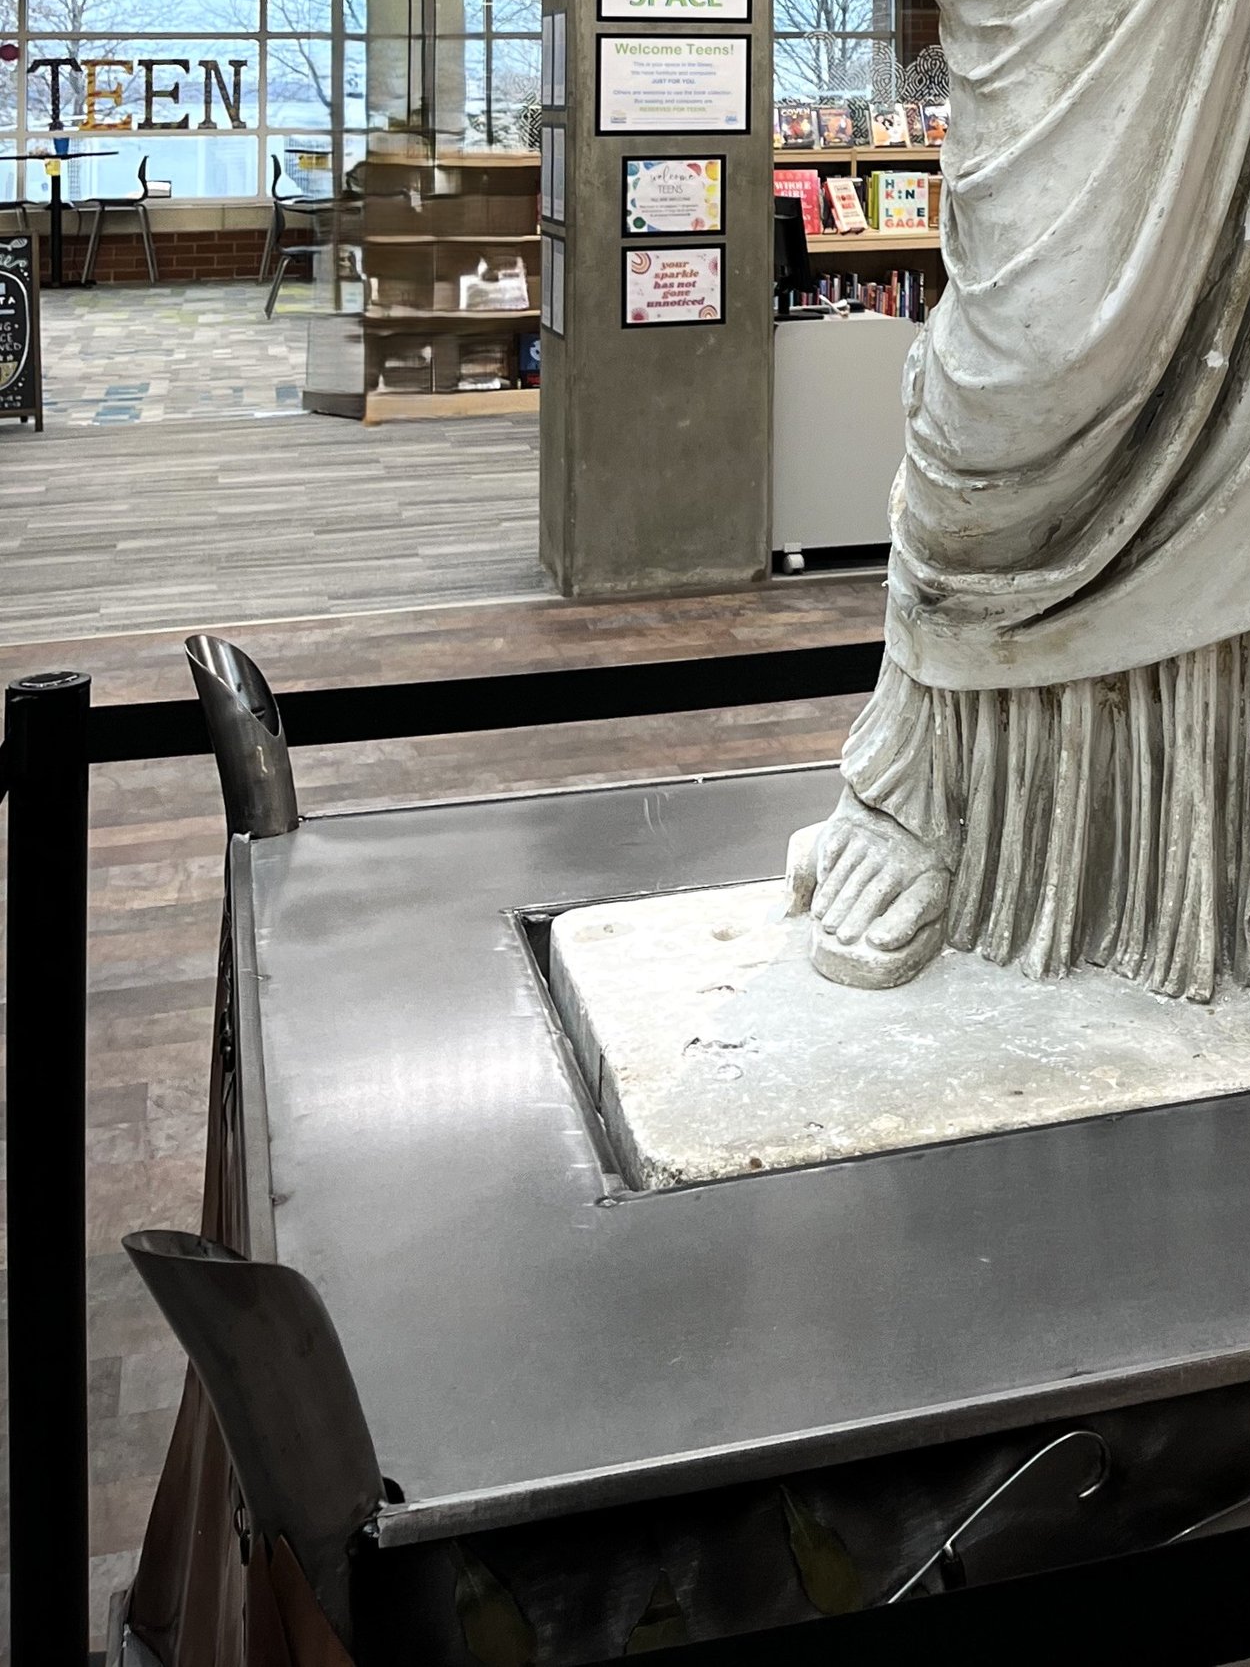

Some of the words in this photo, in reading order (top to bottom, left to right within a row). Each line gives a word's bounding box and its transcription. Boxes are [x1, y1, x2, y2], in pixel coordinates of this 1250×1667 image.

[614, 43, 682, 55] Welcome
[686, 44, 734, 55] Teens!
[26, 58, 248, 131] TEEN
[658, 185, 683, 194] TEENS
[661, 261, 689, 270] your
[654, 270, 699, 281] sparkle
[653, 281, 675, 289] has
[662, 290, 691, 299] gone
[647, 297, 705, 308] unnoticed
